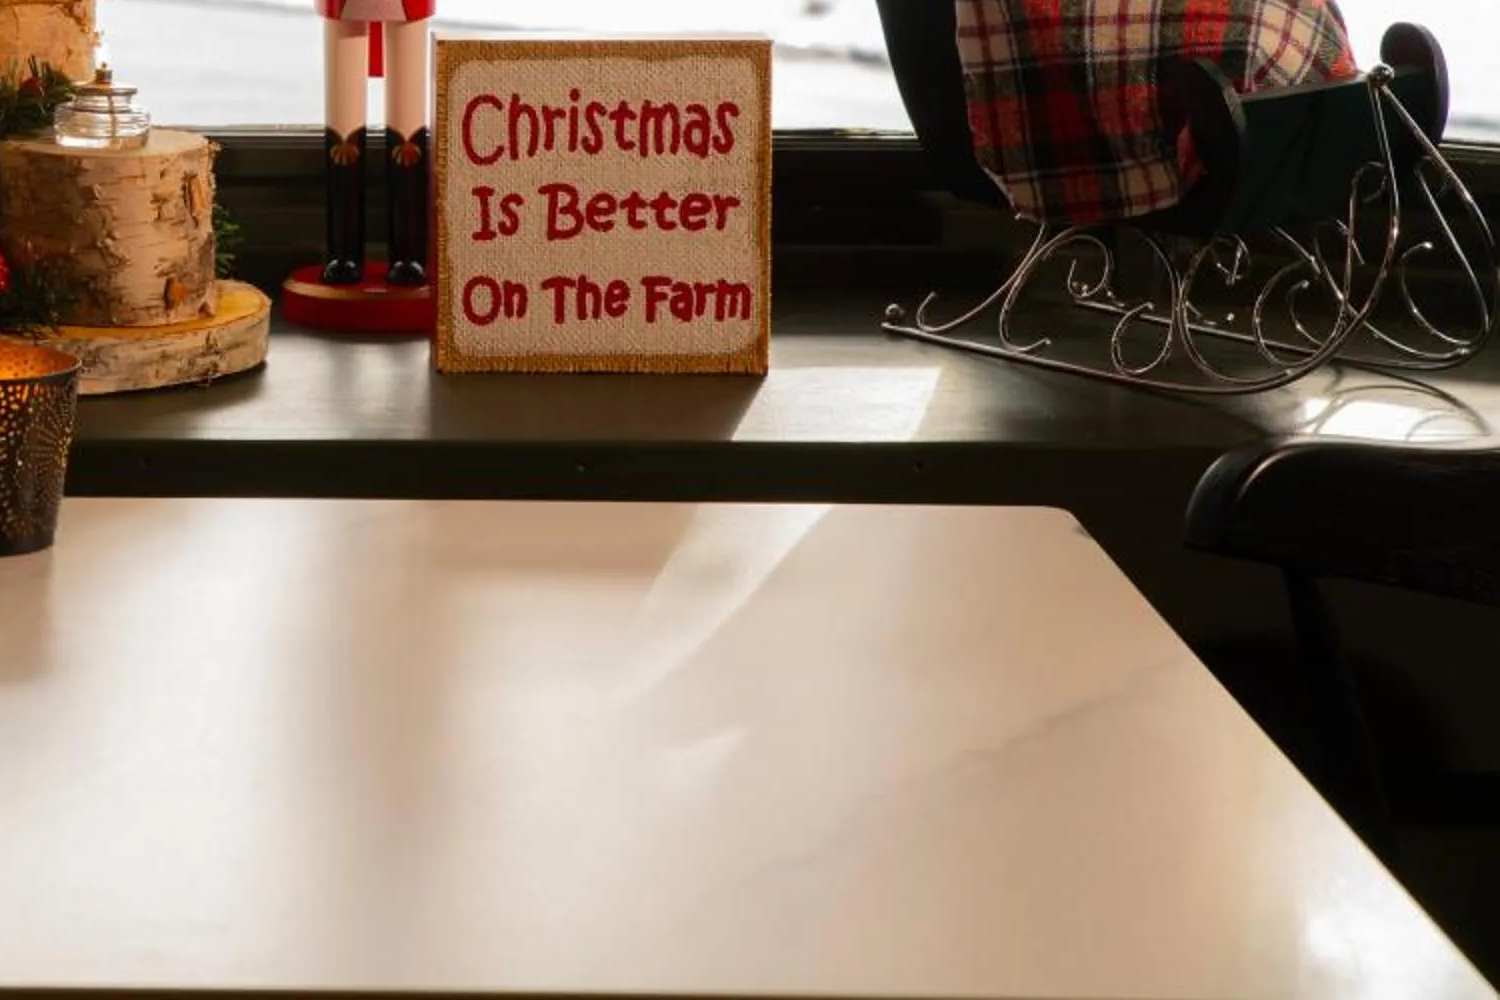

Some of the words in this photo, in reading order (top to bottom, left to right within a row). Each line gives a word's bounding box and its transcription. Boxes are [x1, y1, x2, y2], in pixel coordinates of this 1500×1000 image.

[462, 88, 739, 166] Christmas
[472, 186, 524, 240] Is
[538, 183, 740, 241] Better
[462, 275, 528, 326] On
[541, 274, 630, 324] The
[640, 275, 750, 323] Farm
